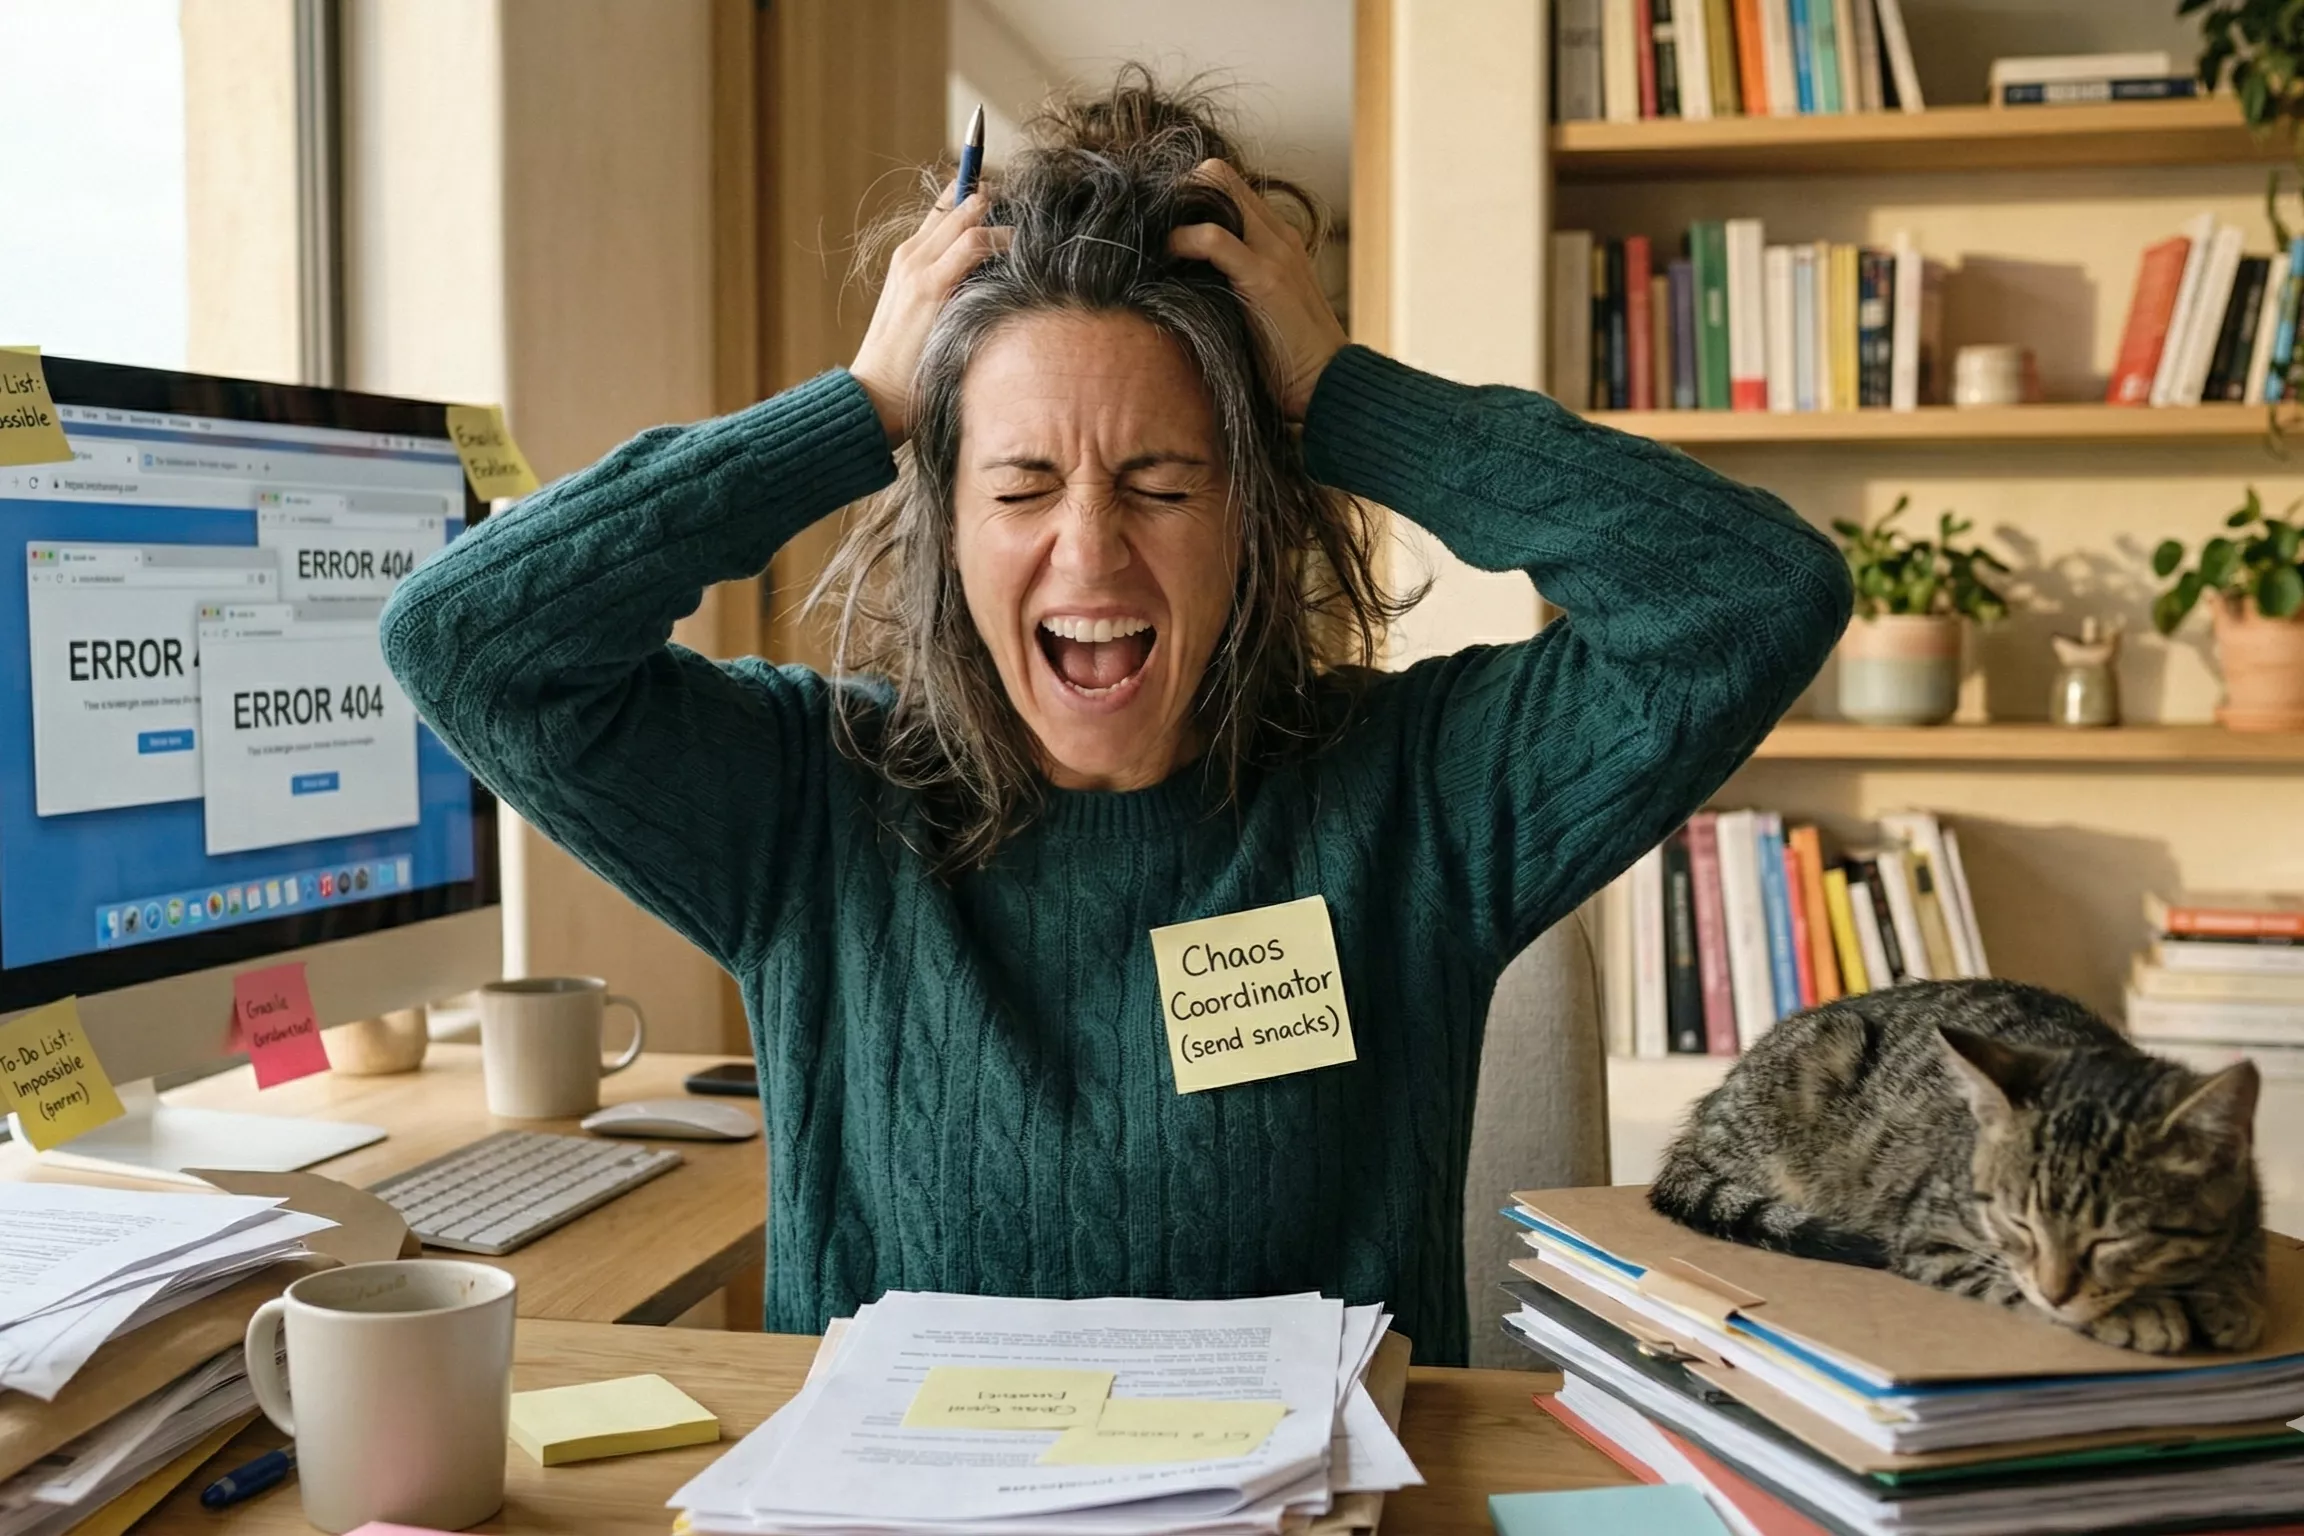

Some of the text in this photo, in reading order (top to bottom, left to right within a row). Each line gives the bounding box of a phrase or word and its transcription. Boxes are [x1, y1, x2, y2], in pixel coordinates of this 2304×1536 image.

[3, 372, 41, 394] List:
[0, 406, 51, 428] ossible
[299, 549, 413, 579] ERROR 404
[70, 638, 184, 681] ERROR
[234, 687, 332, 729] ERROR
[340, 684, 384, 719] 404
[1182, 939, 1284, 976] Chaos
[1171, 968, 1332, 1020] Coordinator
[0, 1028, 74, 1073] To-Do List:
[1181, 1005, 1339, 1063] (send snacks)
[13, 1055, 84, 1098] Impossible
